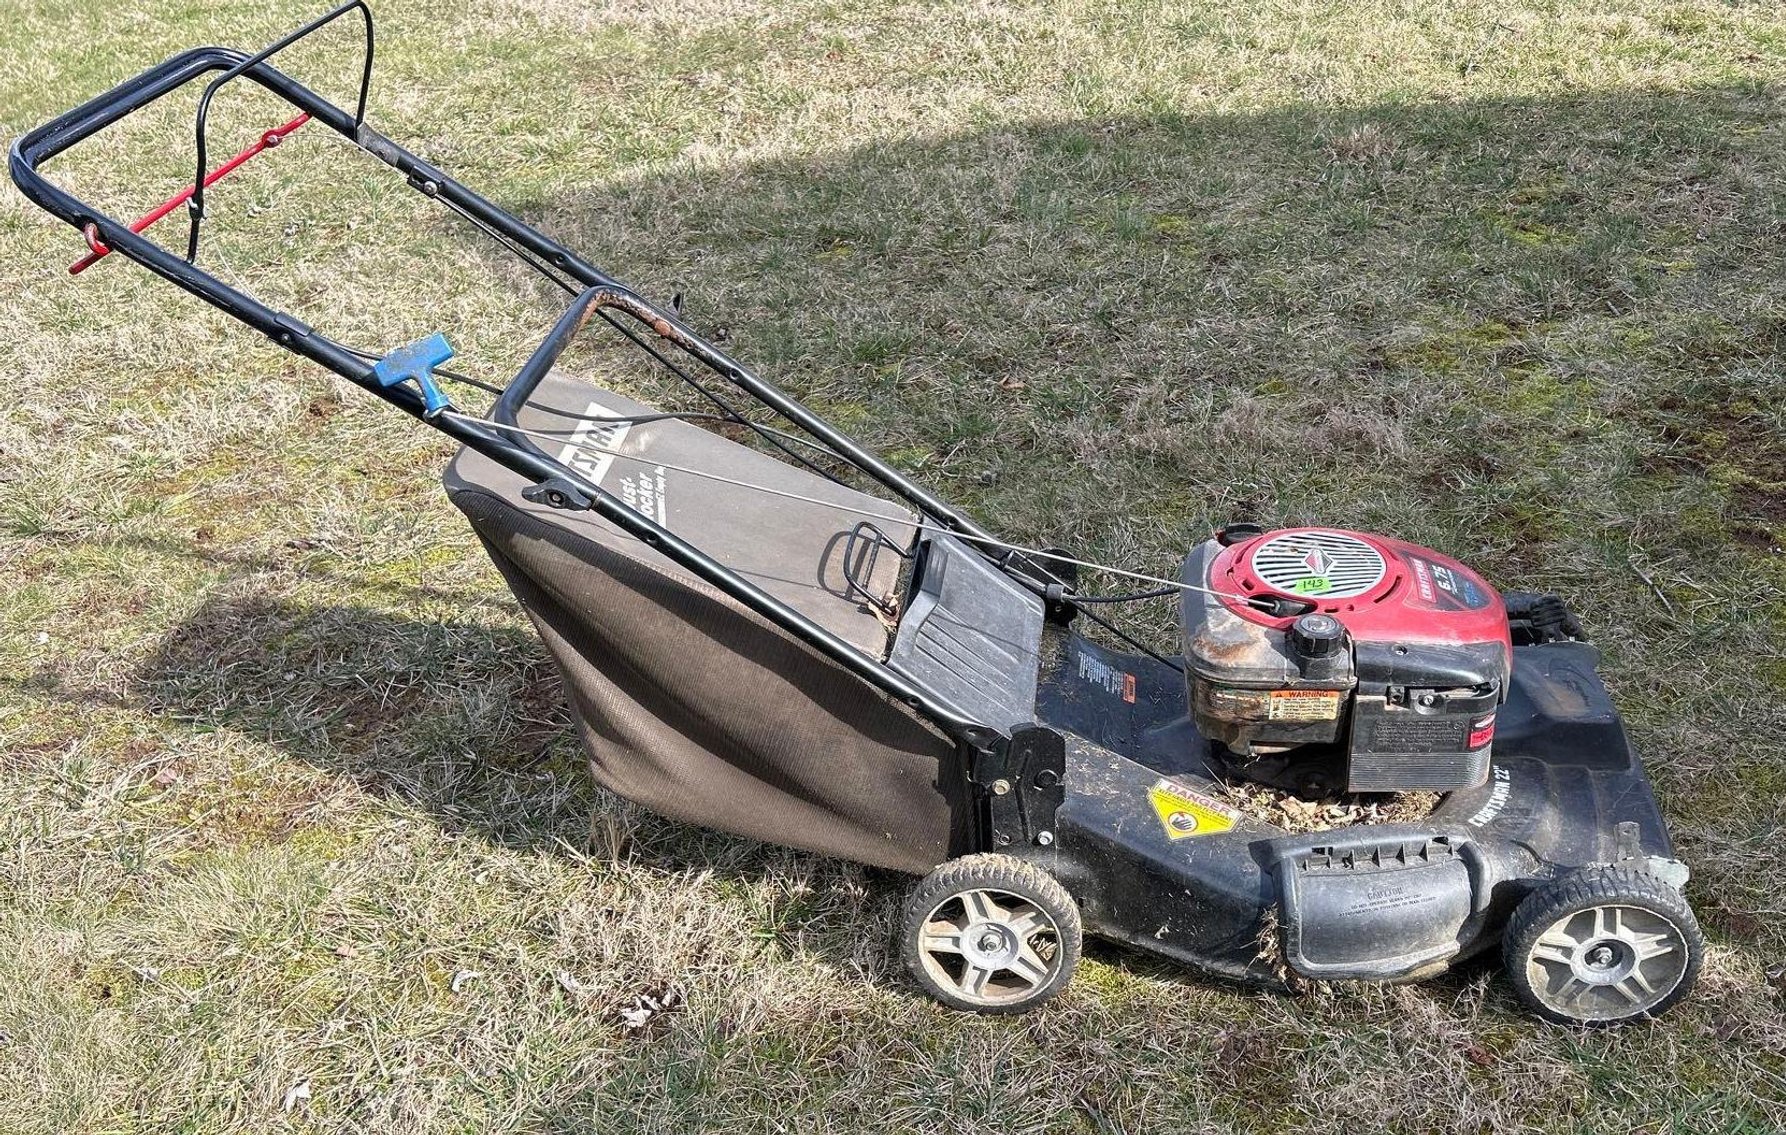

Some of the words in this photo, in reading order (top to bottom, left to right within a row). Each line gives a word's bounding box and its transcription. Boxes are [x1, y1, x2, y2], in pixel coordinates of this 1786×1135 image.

[567, 414, 620, 477] TSMAN
[637, 472, 654, 519] ocker
[1303, 579, 1323, 589] 143
[1432, 565, 1452, 591] 6.75
[1288, 690, 1328, 698] WARNING
[1167, 784, 1230, 815] DANGER
[1468, 781, 1511, 827] CRAFTSMAN
